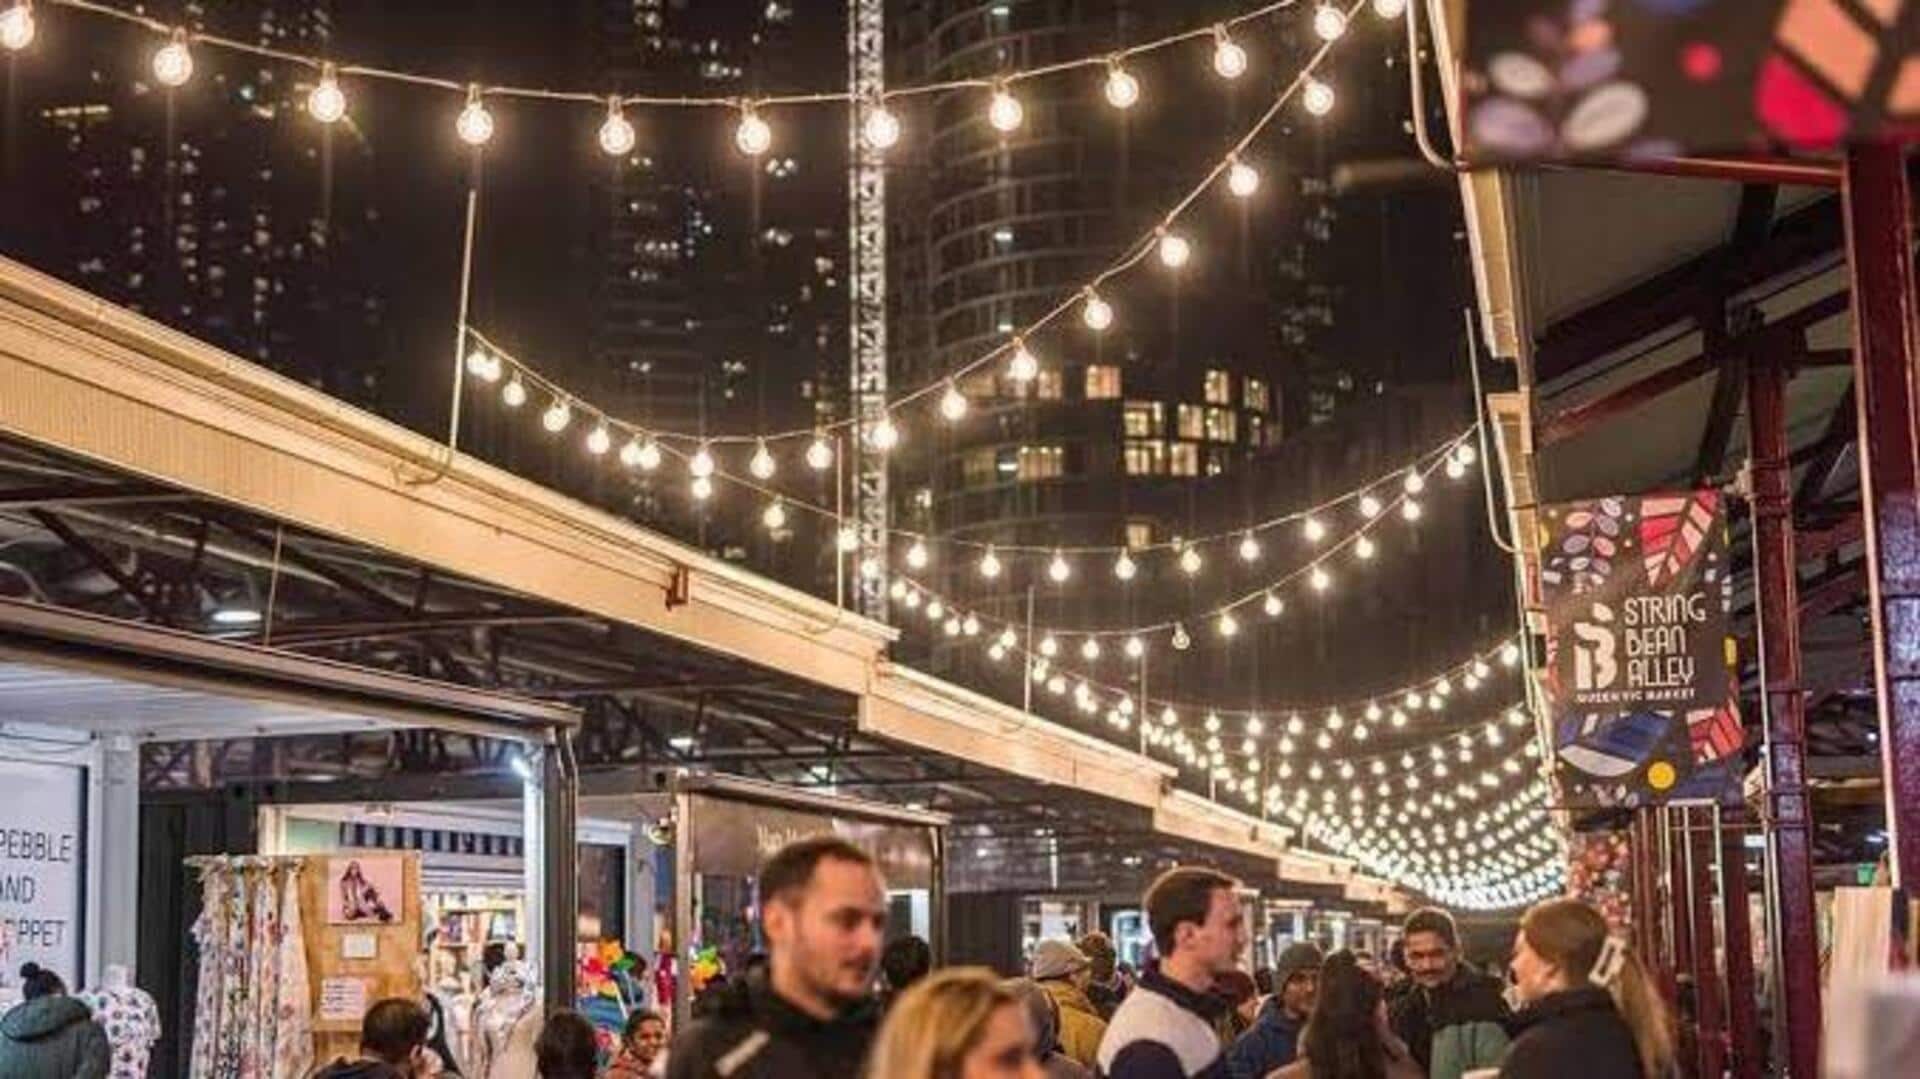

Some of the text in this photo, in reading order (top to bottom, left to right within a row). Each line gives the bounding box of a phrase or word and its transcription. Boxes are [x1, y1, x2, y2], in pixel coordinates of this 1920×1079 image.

[1624, 592, 1707, 625] STRING
[1624, 625, 1686, 657] BEAN
[1627, 656, 1695, 687] ALLEY
